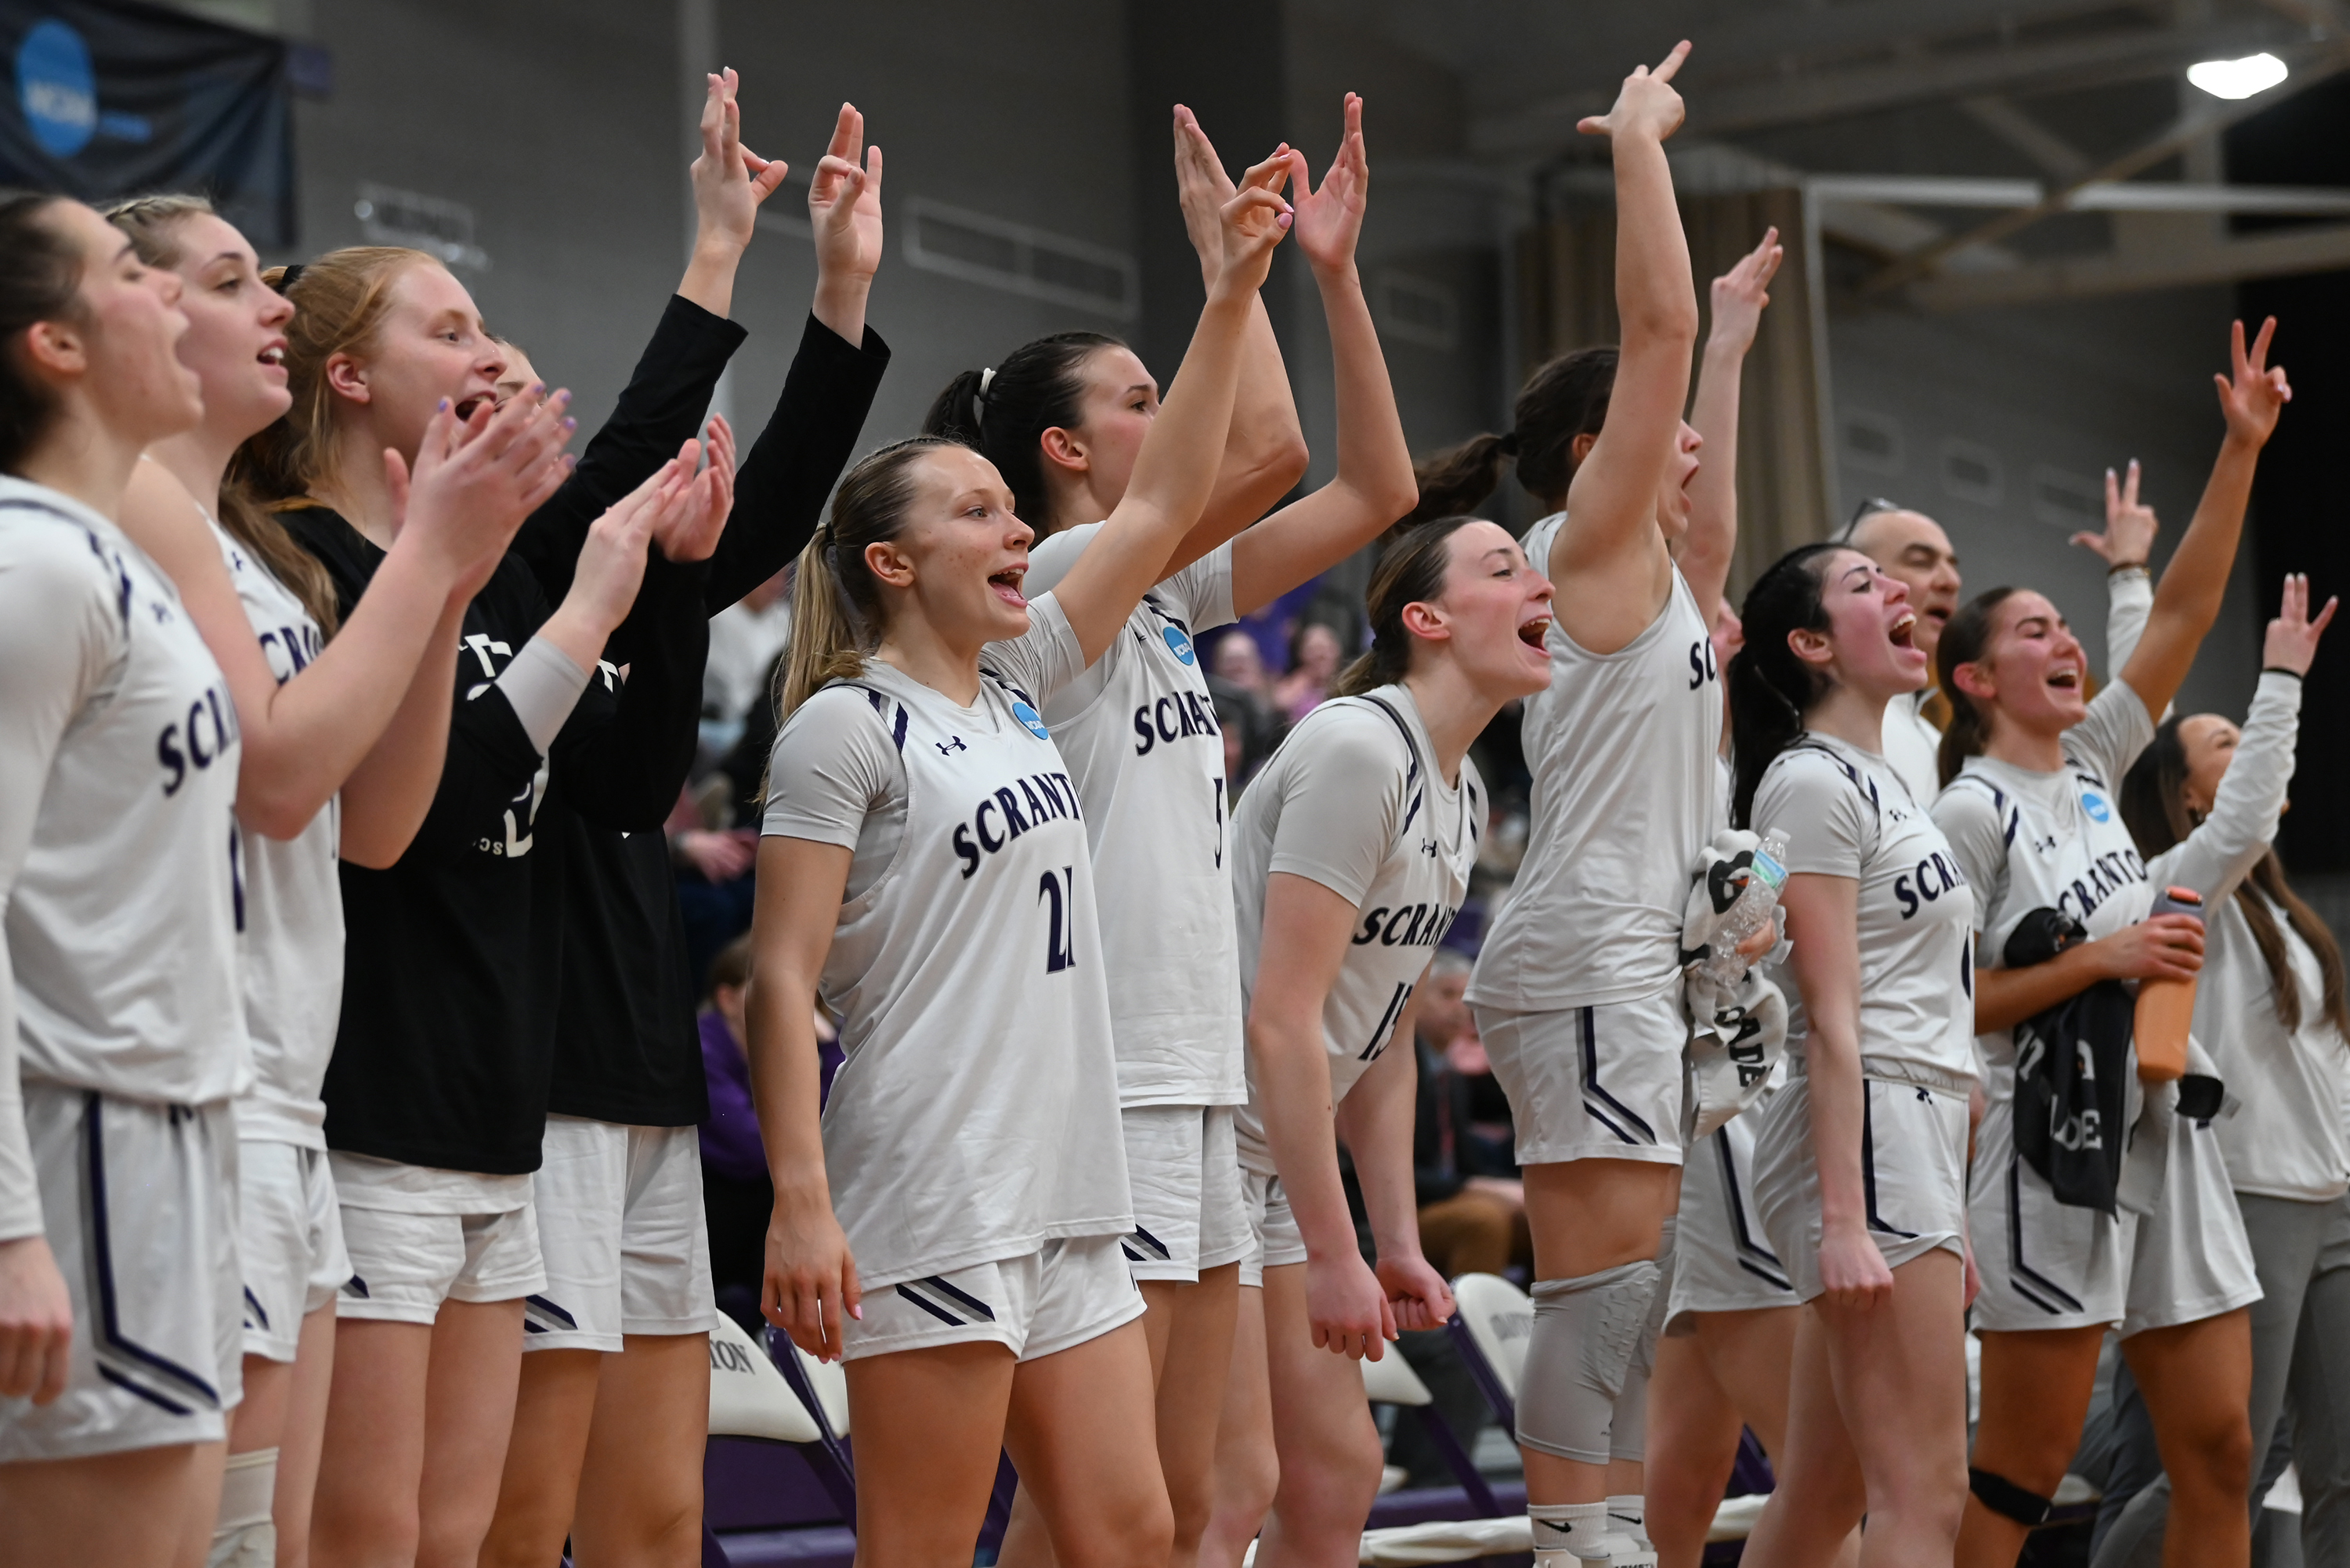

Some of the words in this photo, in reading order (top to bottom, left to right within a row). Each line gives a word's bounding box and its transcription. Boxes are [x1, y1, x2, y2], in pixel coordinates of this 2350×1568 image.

[1173, 642, 1192, 657] NCAA
[1024, 720, 1046, 730] NCAA
[953, 771, 1086, 880] SCRANT
[1038, 865, 1076, 975] 21
